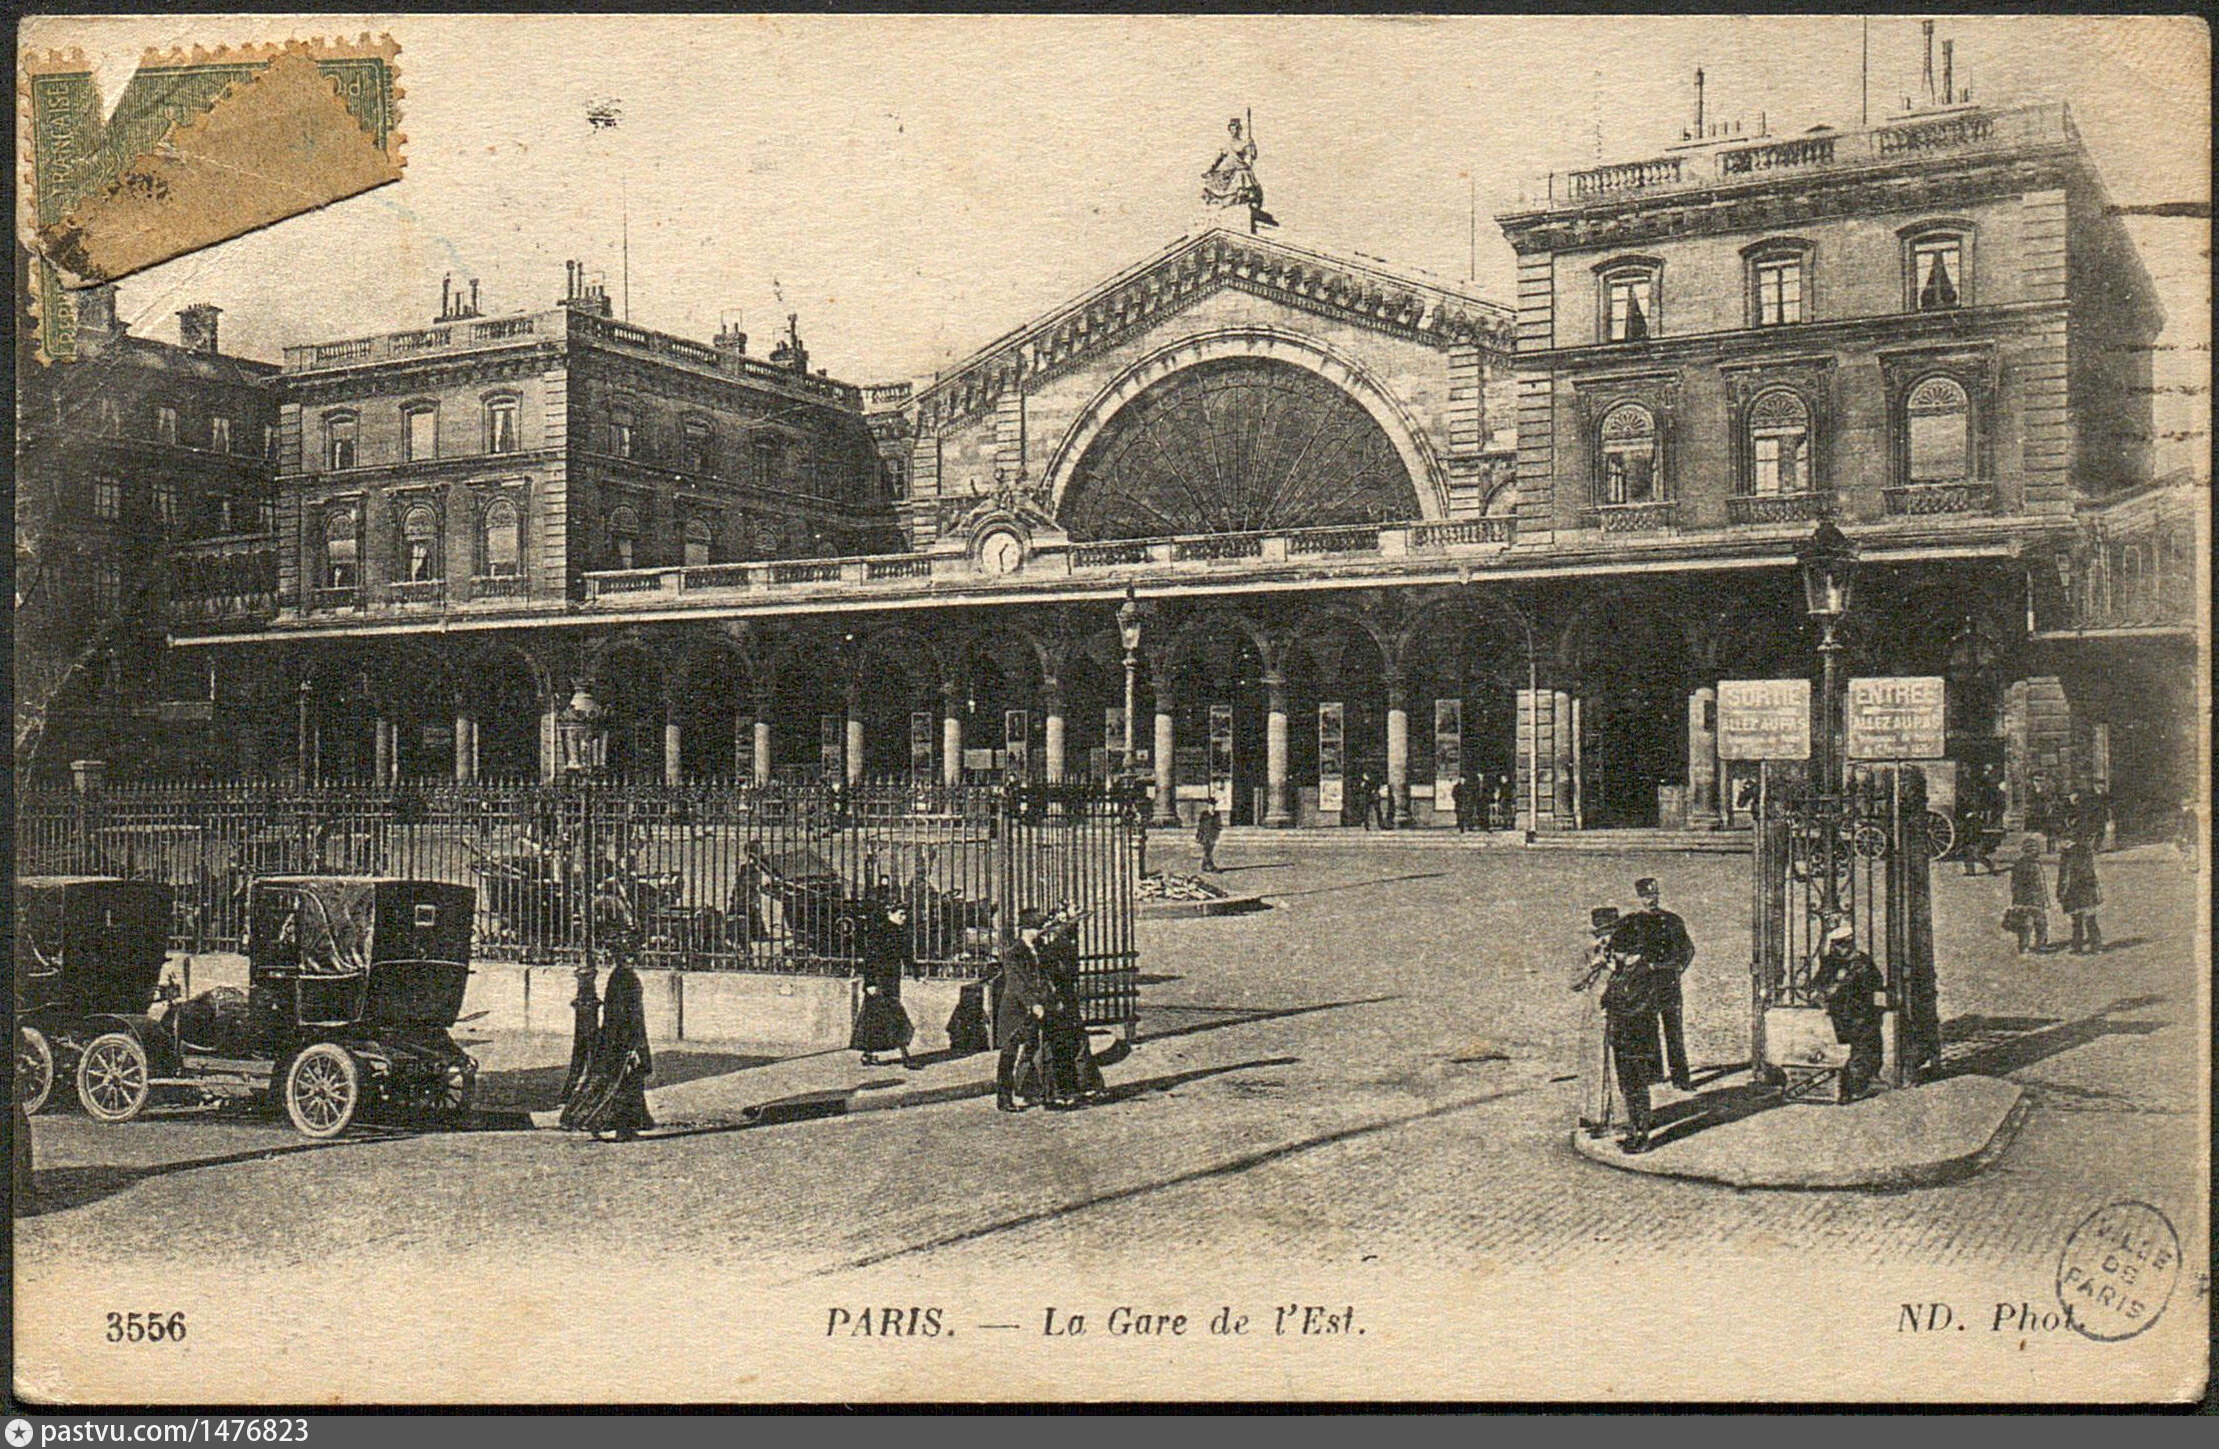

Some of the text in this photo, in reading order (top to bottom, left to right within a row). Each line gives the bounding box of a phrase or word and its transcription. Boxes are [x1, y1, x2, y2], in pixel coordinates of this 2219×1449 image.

[1727, 687, 1803, 706] SORTIE
[2064, 1266, 2146, 1319] PARIS
[106, 1311, 187, 1342] 3556
[827, 1307, 955, 1337] PARIS.
[1044, 1307, 1086, 1336] La
[1108, 1307, 1188, 1336] Gare
[1211, 1306, 1250, 1335] de
[1899, 1303, 2086, 1332] ND. Phot.
